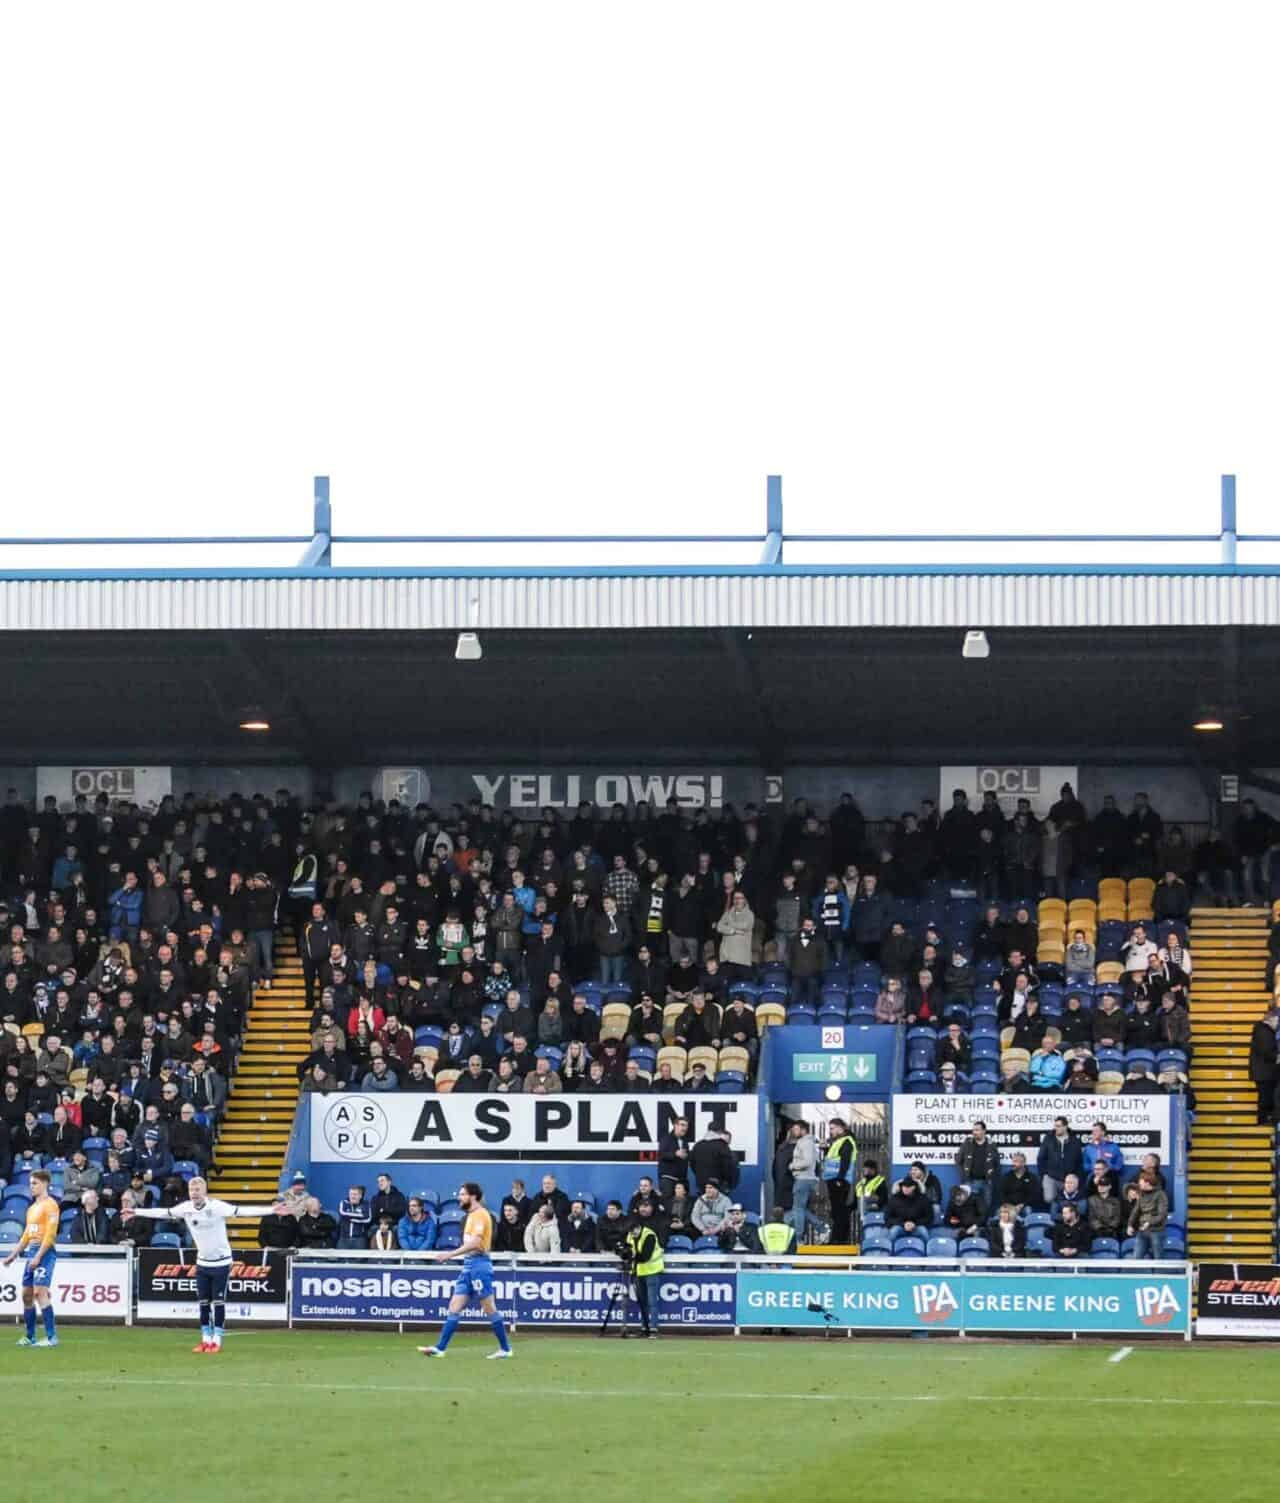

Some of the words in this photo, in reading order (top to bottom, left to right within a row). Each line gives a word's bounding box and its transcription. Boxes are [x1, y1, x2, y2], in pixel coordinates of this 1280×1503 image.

[74, 770, 133, 794] OCL
[980, 768, 1039, 792] OCL
[824, 1032, 842, 1044] 20
[799, 1062, 824, 1073] EXIT
[915, 1098, 958, 1109] PLANT
[962, 1098, 995, 1109] HIRE
[1007, 1098, 1088, 1110] TARMACING
[1099, 1098, 1150, 1110] UTILITY
[336, 1106, 350, 1121] A
[362, 1106, 375, 1121] S
[410, 1100, 453, 1142] A
[474, 1099, 512, 1143] S
[534, 1100, 738, 1143] PLANT
[917, 1114, 955, 1123] SEWER
[959, 1114, 966, 1123] &
[968, 1113, 997, 1123] CIVIL
[1074, 1113, 1151, 1124] CONTRACTOR
[337, 1133, 350, 1148] P
[362, 1133, 374, 1148] L
[152, 1279, 269, 1293] STEEORK
[58, 1285, 86, 1303] 75
[91, 1285, 120, 1303] 85
[748, 1291, 835, 1309] GREENE
[843, 1292, 900, 1310] KING
[912, 1281, 959, 1314] IPA
[969, 1294, 1057, 1312] GREENE
[1064, 1295, 1120, 1313] KING
[1134, 1284, 1182, 1317] IPA
[301, 1305, 356, 1315] Extensions
[370, 1306, 425, 1317] Orangeries
[532, 1309, 571, 1320] 07762
[574, 1309, 598, 1320] 032
